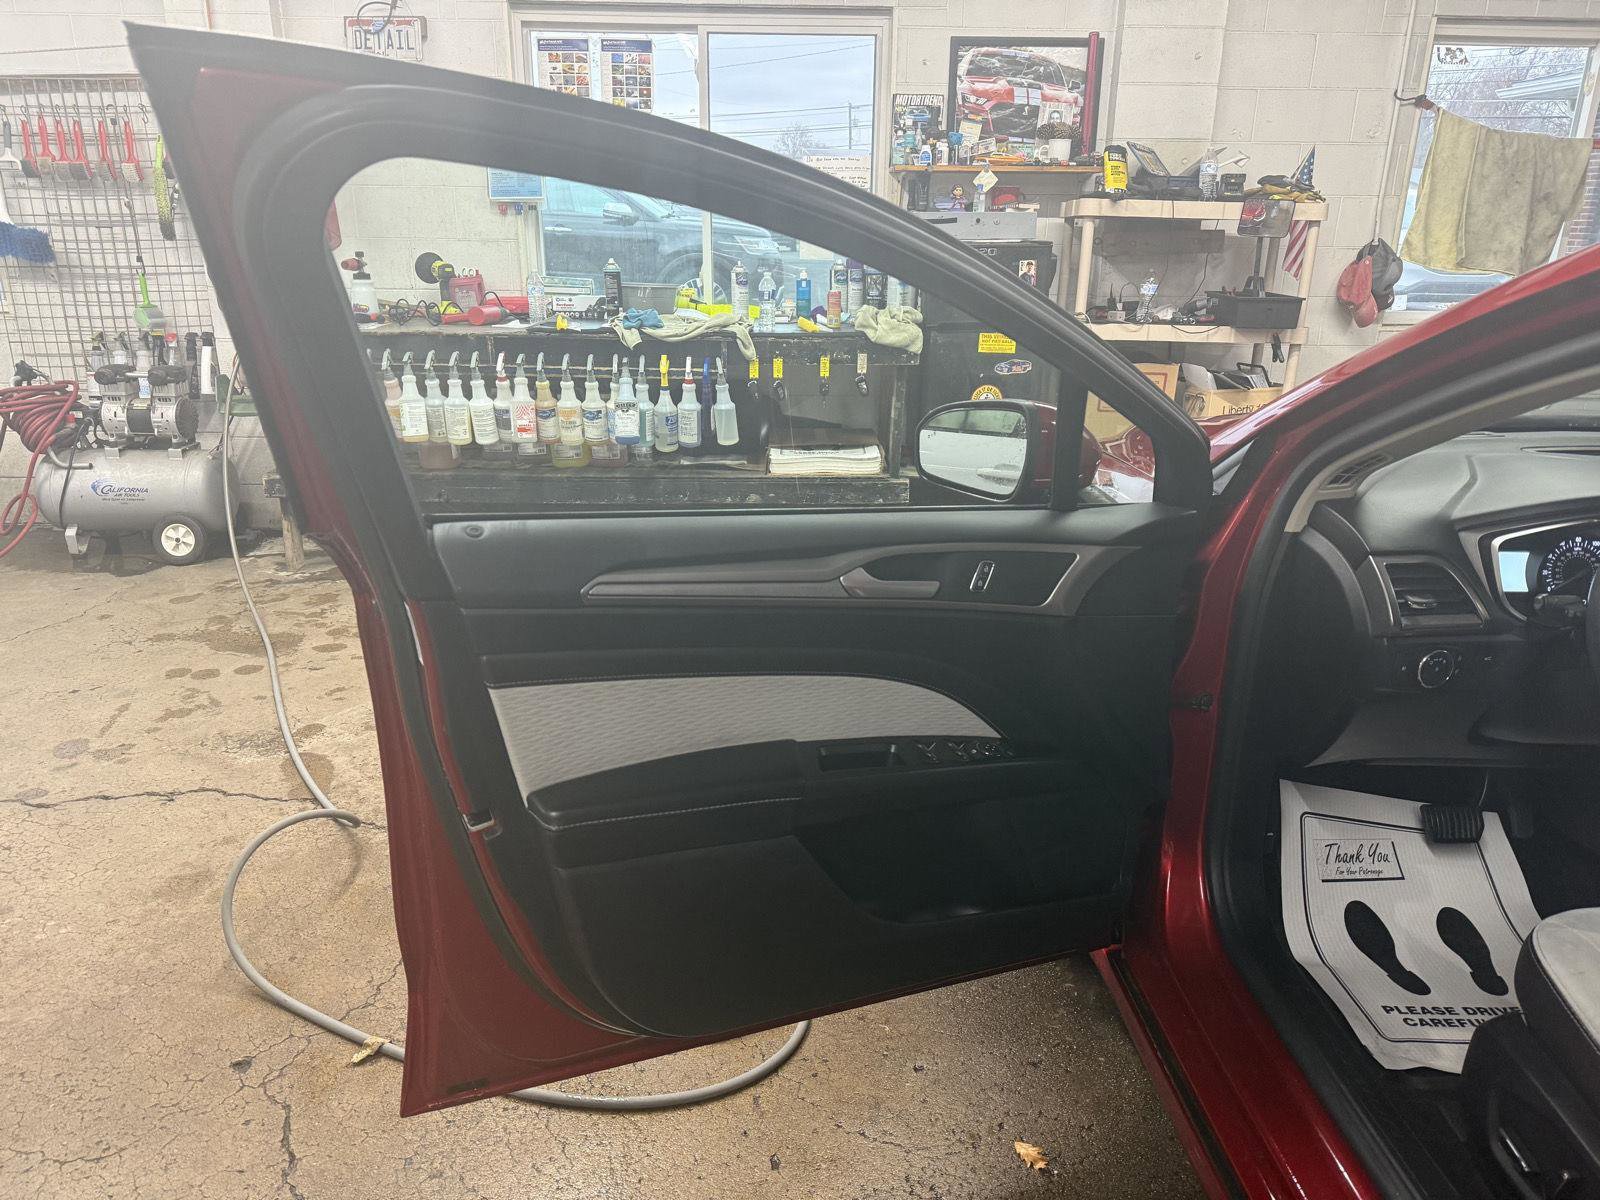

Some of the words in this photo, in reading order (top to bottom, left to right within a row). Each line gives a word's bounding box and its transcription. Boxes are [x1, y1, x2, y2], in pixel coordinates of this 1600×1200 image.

[354, 28, 416, 51] DETAIL
[101, 484, 149, 494] CALIFORNIA
[1324, 842, 1365, 865] Thank
[1368, 842, 1391, 865] You
[1335, 866, 1345, 875] For
[1345, 866, 1358, 876] Your
[1381, 1005, 1460, 1016] PLEASE
